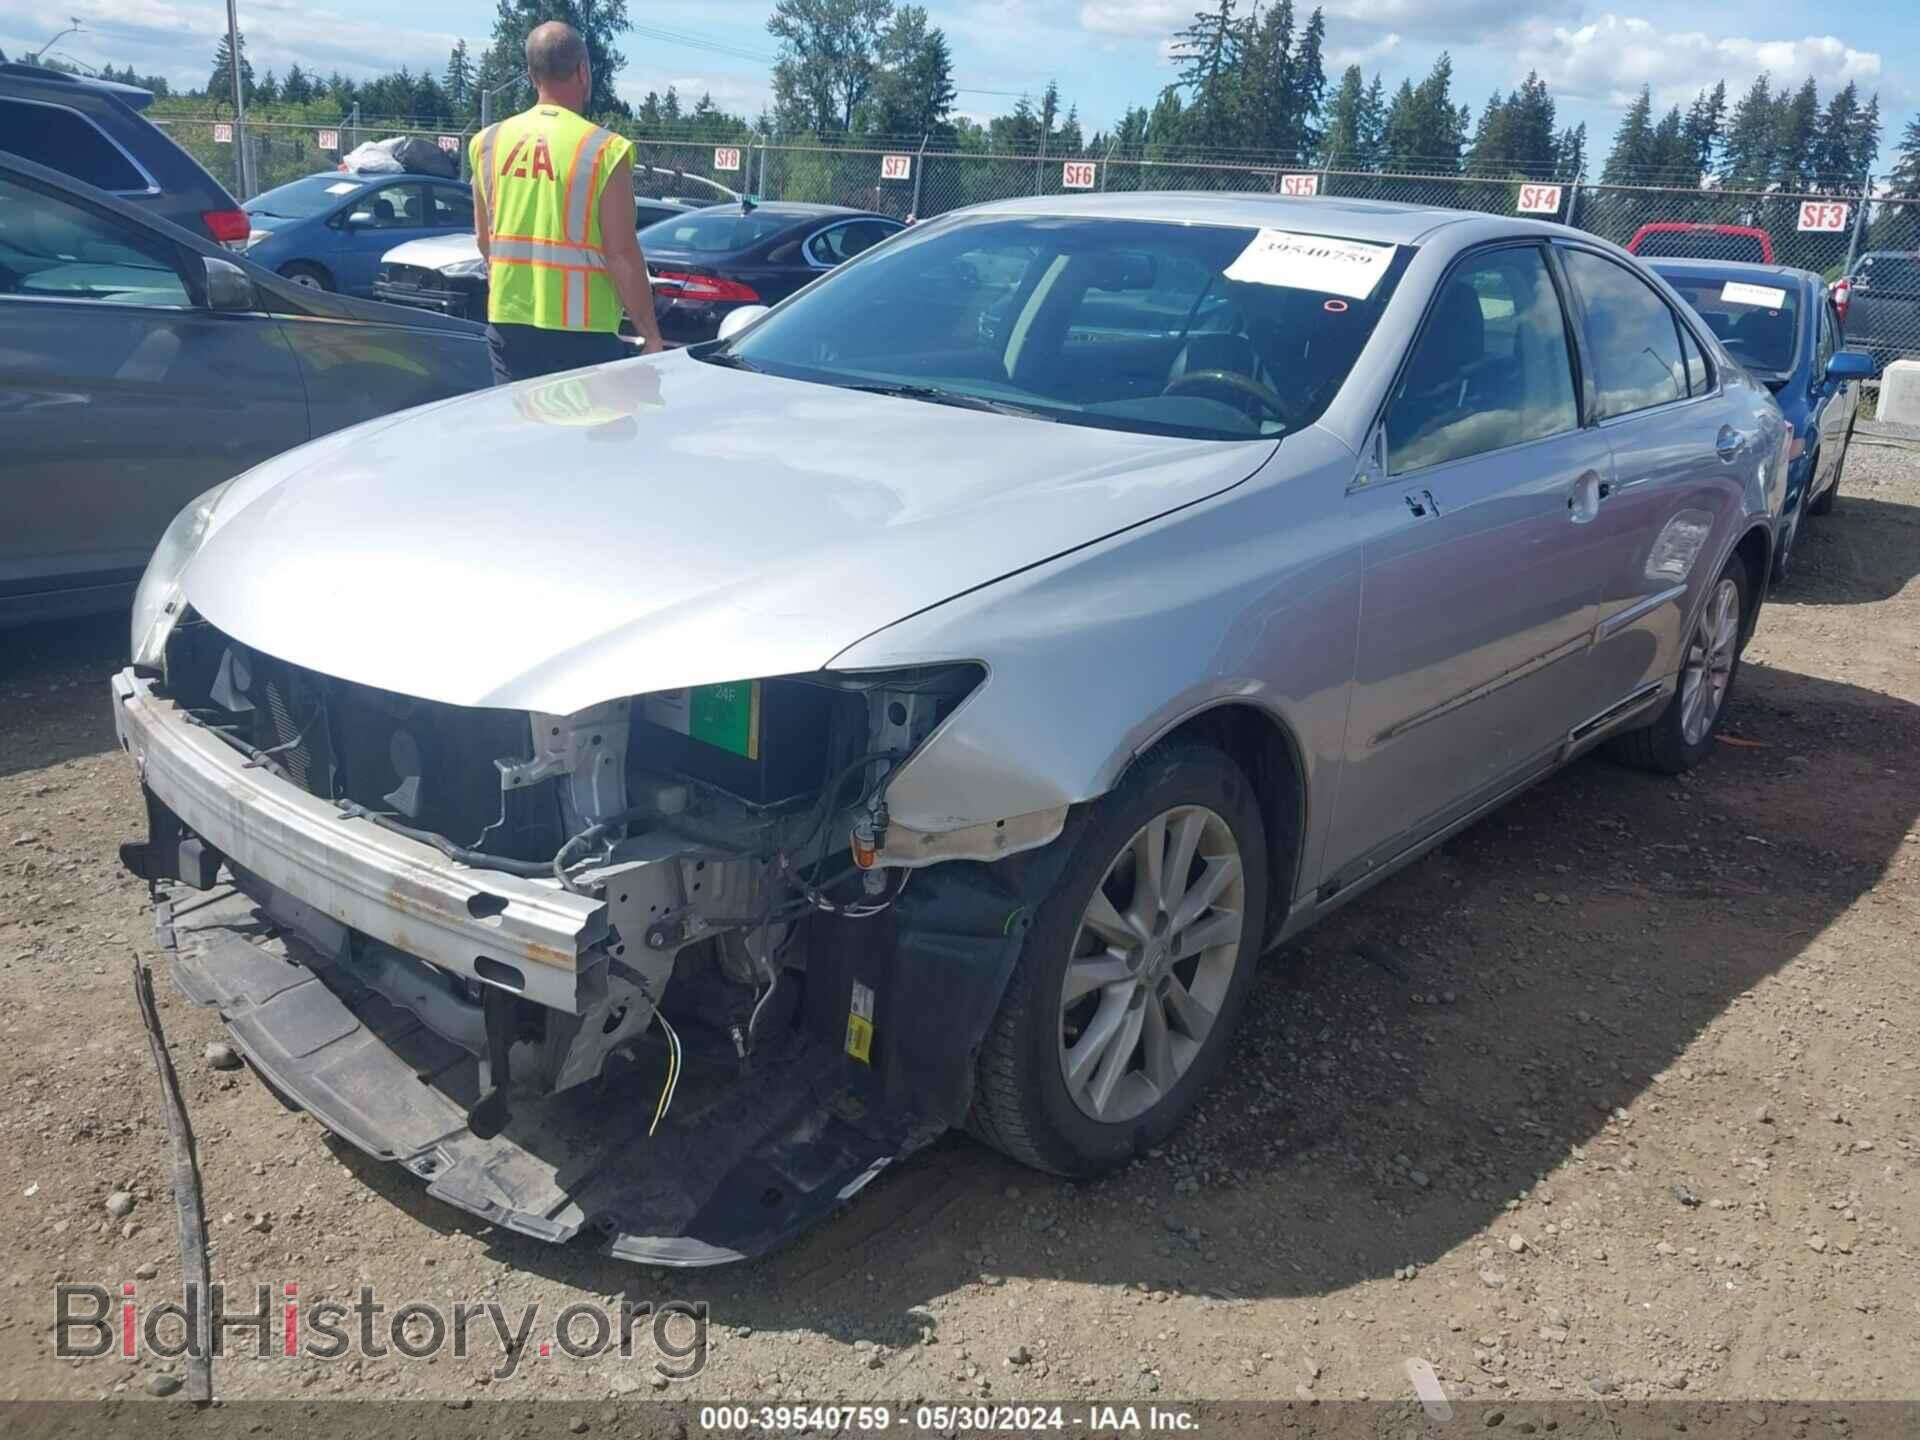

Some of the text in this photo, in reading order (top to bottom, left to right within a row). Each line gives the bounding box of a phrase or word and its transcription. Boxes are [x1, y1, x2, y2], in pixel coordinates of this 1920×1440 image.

[717, 151, 738, 167] SF8
[885, 159, 906, 176] SF7
[1066, 166, 1092, 184] SF6
[1285, 177, 1313, 195] SF5
[1522, 188, 1557, 209] SF4
[1802, 205, 1843, 228] SF3
